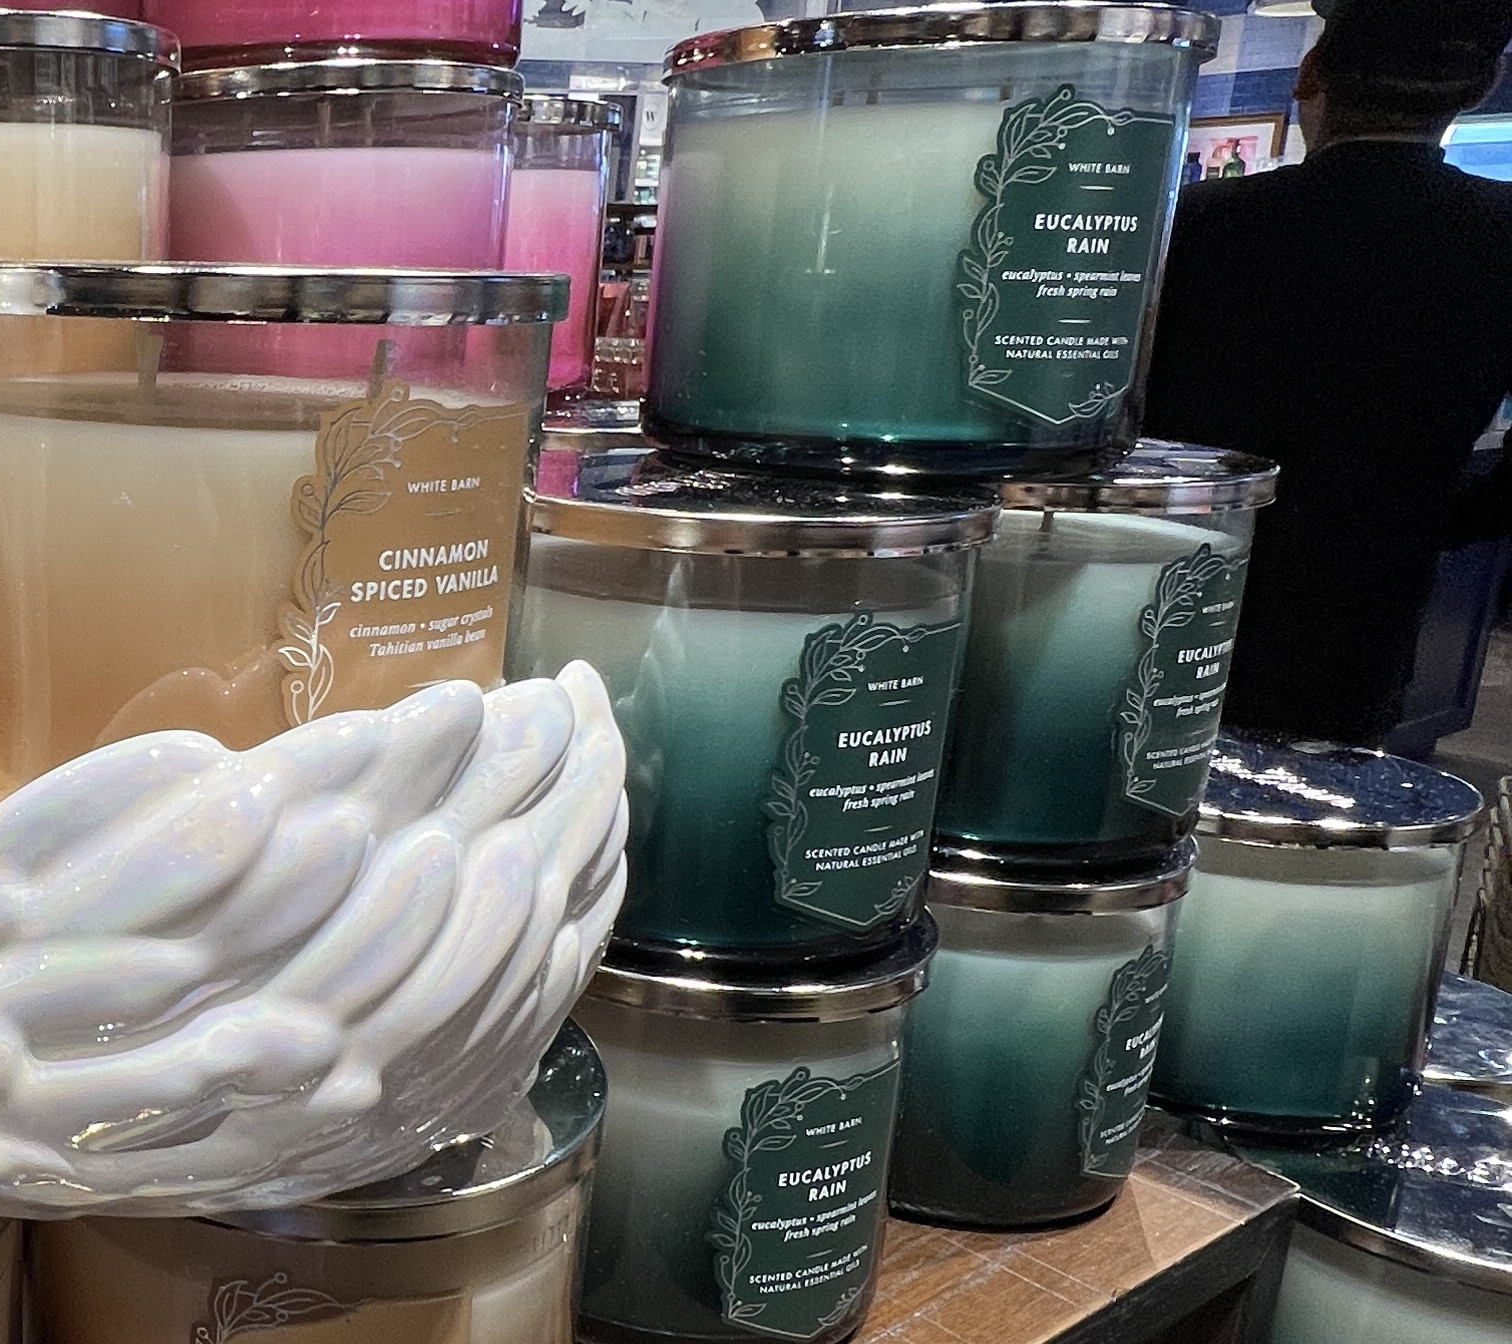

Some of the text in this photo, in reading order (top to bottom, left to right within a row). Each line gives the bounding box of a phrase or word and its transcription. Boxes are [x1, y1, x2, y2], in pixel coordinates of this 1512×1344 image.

[1068, 162, 1101, 174] WHITE
[1034, 213, 1138, 232] EUCALYPTUS
[1067, 238, 1110, 254] RAIN
[1002, 269, 1063, 282] eucalyptus
[1036, 284, 1065, 298] fresh
[1066, 285, 1098, 298] spring
[995, 335, 1043, 345] SCENTED
[1047, 336, 1084, 345] CANDLE
[1006, 350, 1052, 359] NATURAL
[408, 477, 480, 494] WHITE BARN
[379, 539, 488, 572] CINNAMON
[350, 566, 498, 603] SPICED VANILLA
[350, 623, 416, 637] cinnamon
[428, 616, 459, 632] sugar
[370, 640, 425, 656] Tahitian
[427, 632, 463, 650] vanilla
[868, 680, 898, 692] WHITE
[838, 720, 931, 748] EUCALYPTUS
[869, 748, 907, 768] RAIN
[809, 784, 867, 798] eucalyptus
[843, 797, 868, 812] fresh
[805, 848, 850, 858] SCENTED
[853, 842, 886, 854] CANDLE
[816, 859, 859, 871] NATURAL
[806, 1124, 835, 1137] WHITE
[778, 1151, 872, 1187] EUCALYPTUS
[808, 1180, 847, 1202] RAIN
[751, 1217, 807, 1230] eucalyptus
[784, 1228, 809, 1242] fresh
[749, 1272, 792, 1284] SCENTED
[795, 1263, 828, 1277] CANDLE
[760, 1282, 801, 1293] NATURAL
